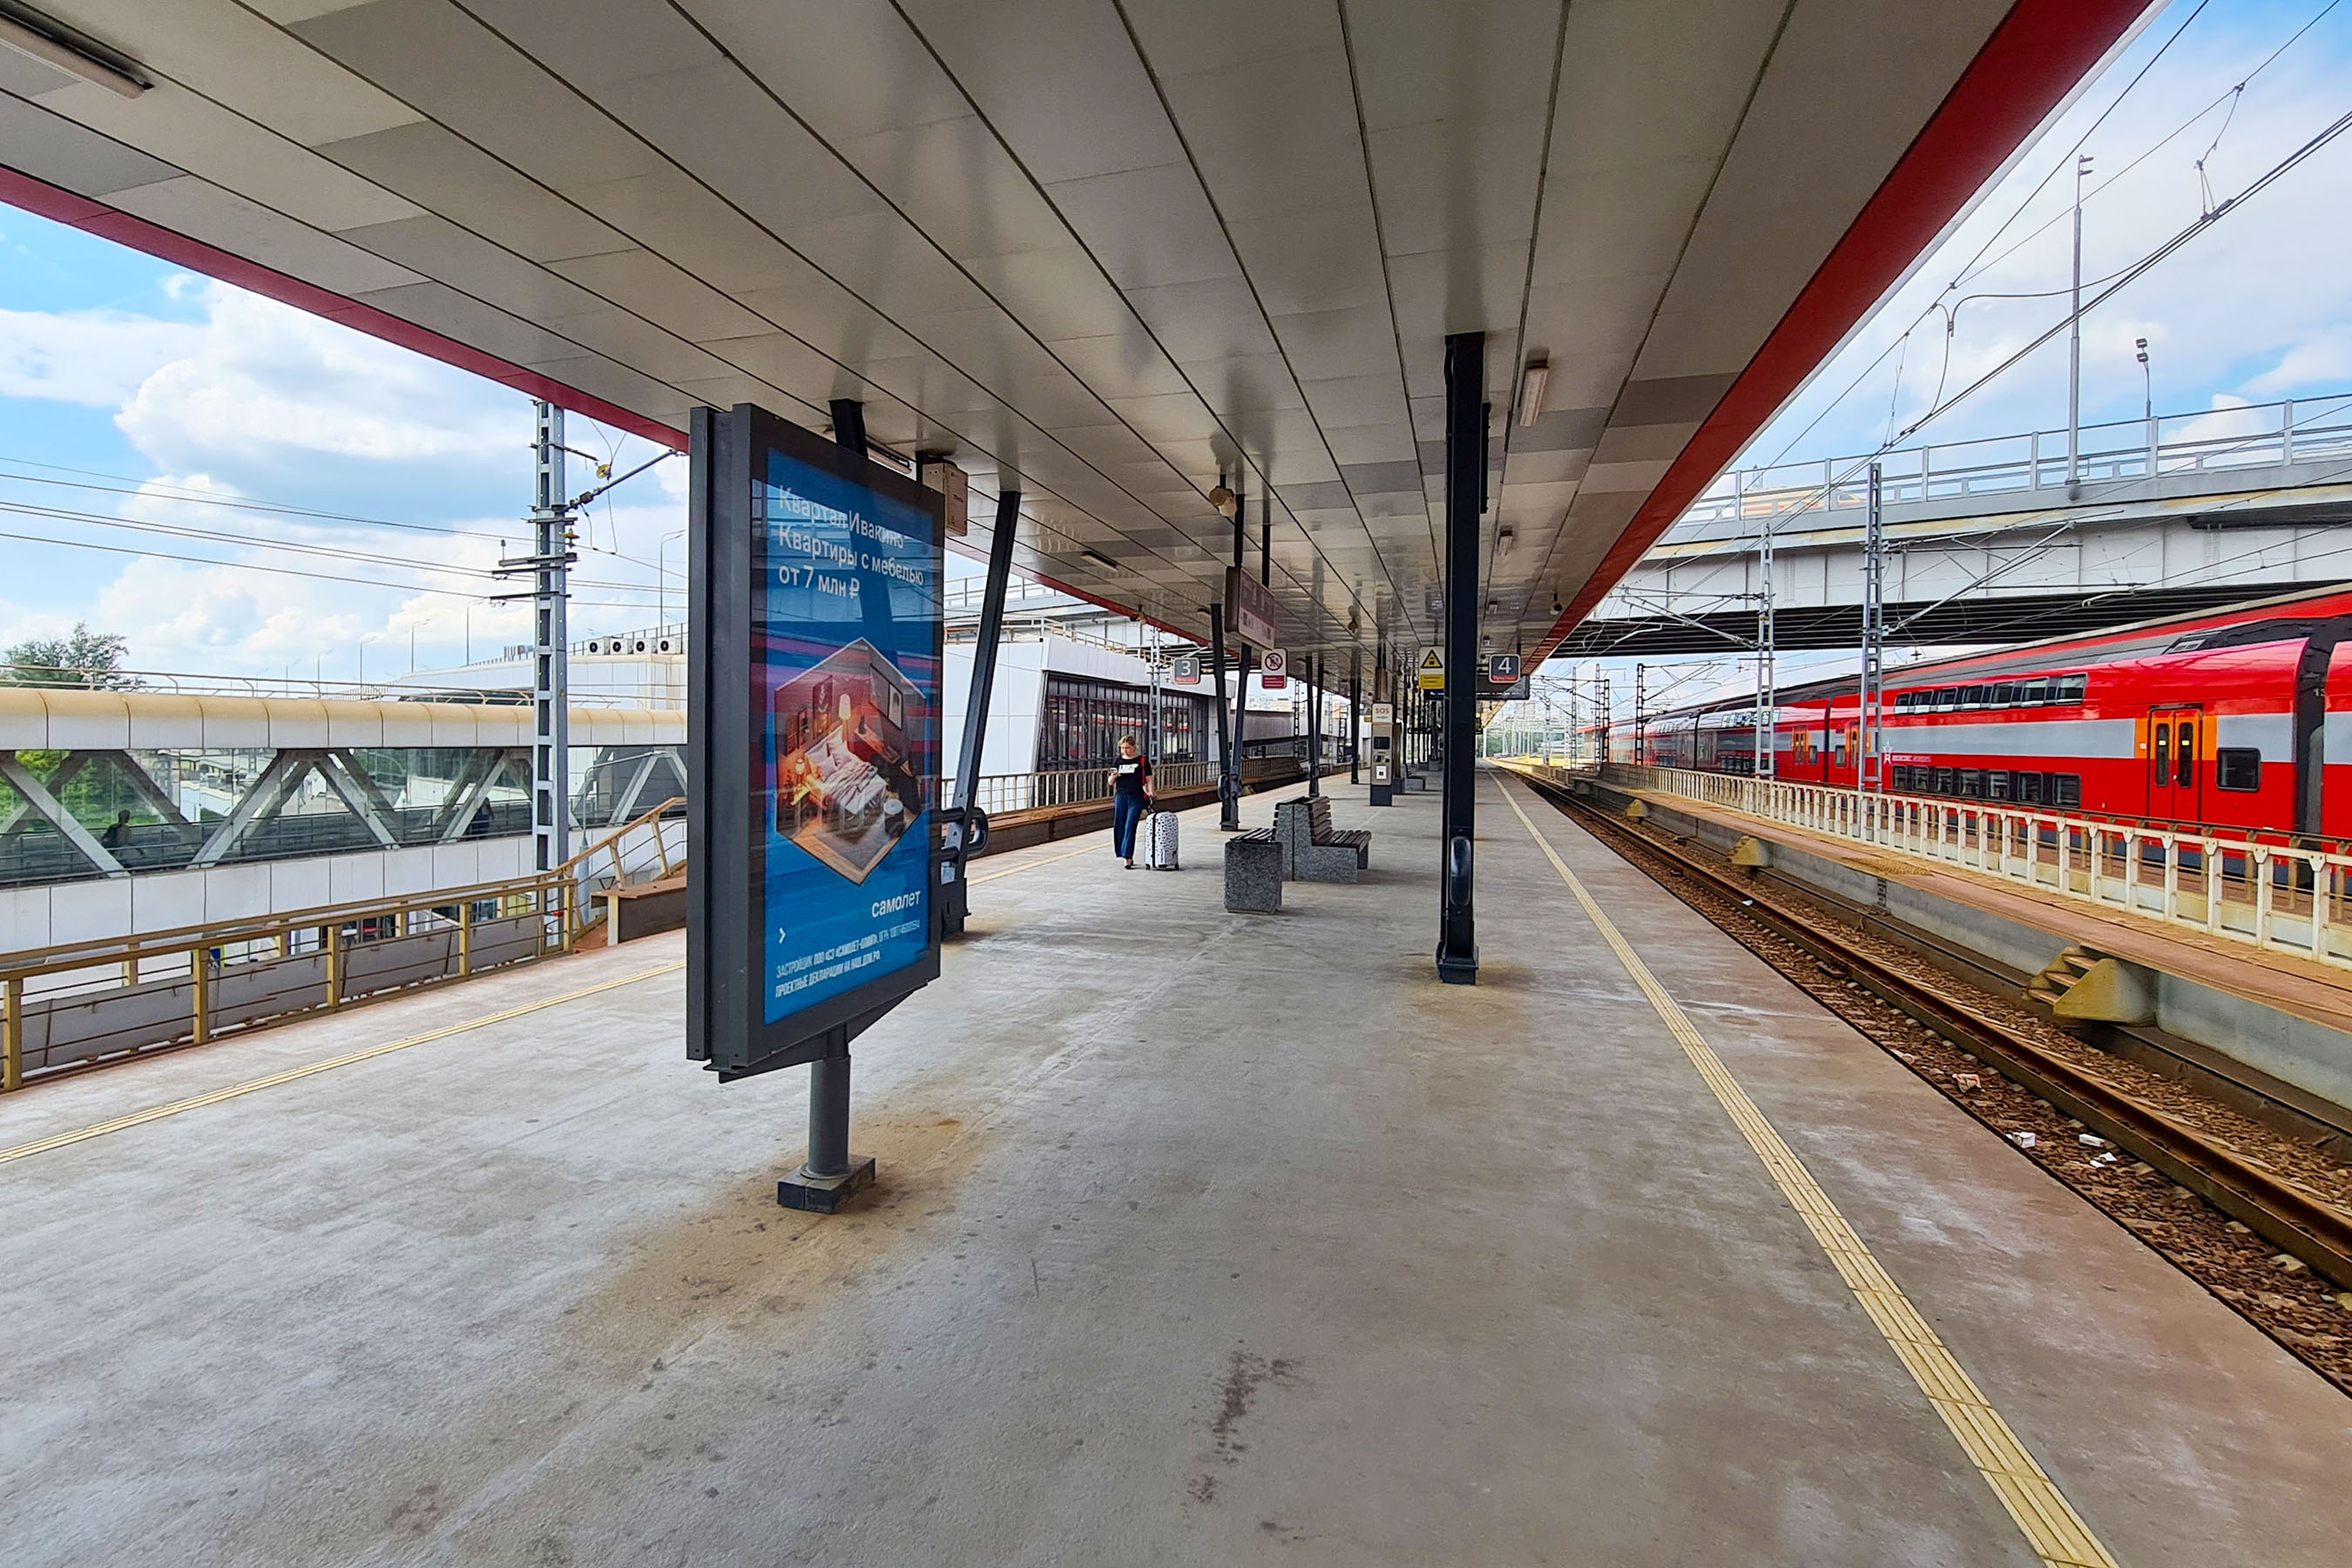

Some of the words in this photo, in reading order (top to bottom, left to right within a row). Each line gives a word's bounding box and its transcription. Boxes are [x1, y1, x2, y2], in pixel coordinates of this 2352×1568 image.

[779, 484, 848, 530] Квартал
[848, 510, 904, 549] Ивакино
[779, 523, 857, 567] Квартиры
[861, 553, 869, 570] с
[871, 557, 923, 586] мебелью
[802, 564, 814, 589] 7
[818, 574, 847, 598] млн
[1180, 659, 1192, 676] 3
[1497, 657, 1512, 674] 4
[871, 890, 922, 918] самолет
